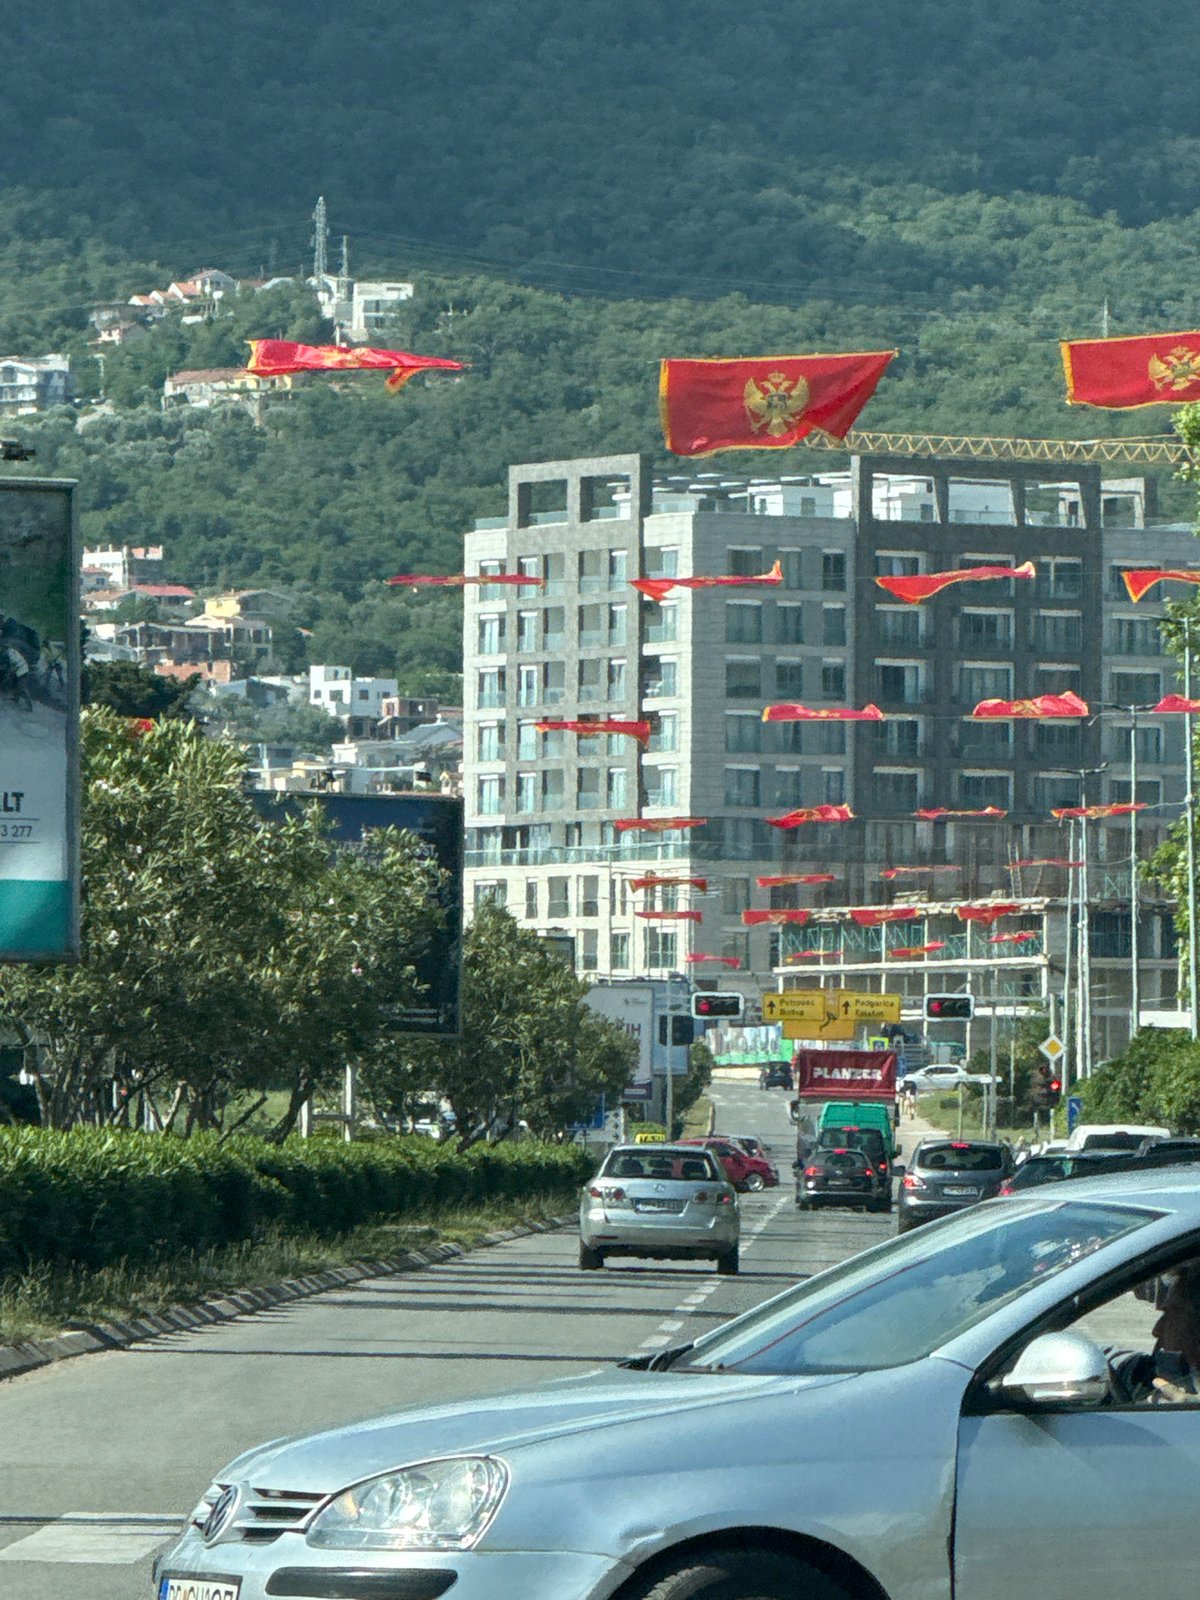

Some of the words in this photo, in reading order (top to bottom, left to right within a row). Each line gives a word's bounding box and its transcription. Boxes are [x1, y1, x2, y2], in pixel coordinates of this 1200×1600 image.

[0, 791, 24, 812] LT
[11, 824, 32, 838] 277
[812, 1067, 882, 1080] PLANZER
